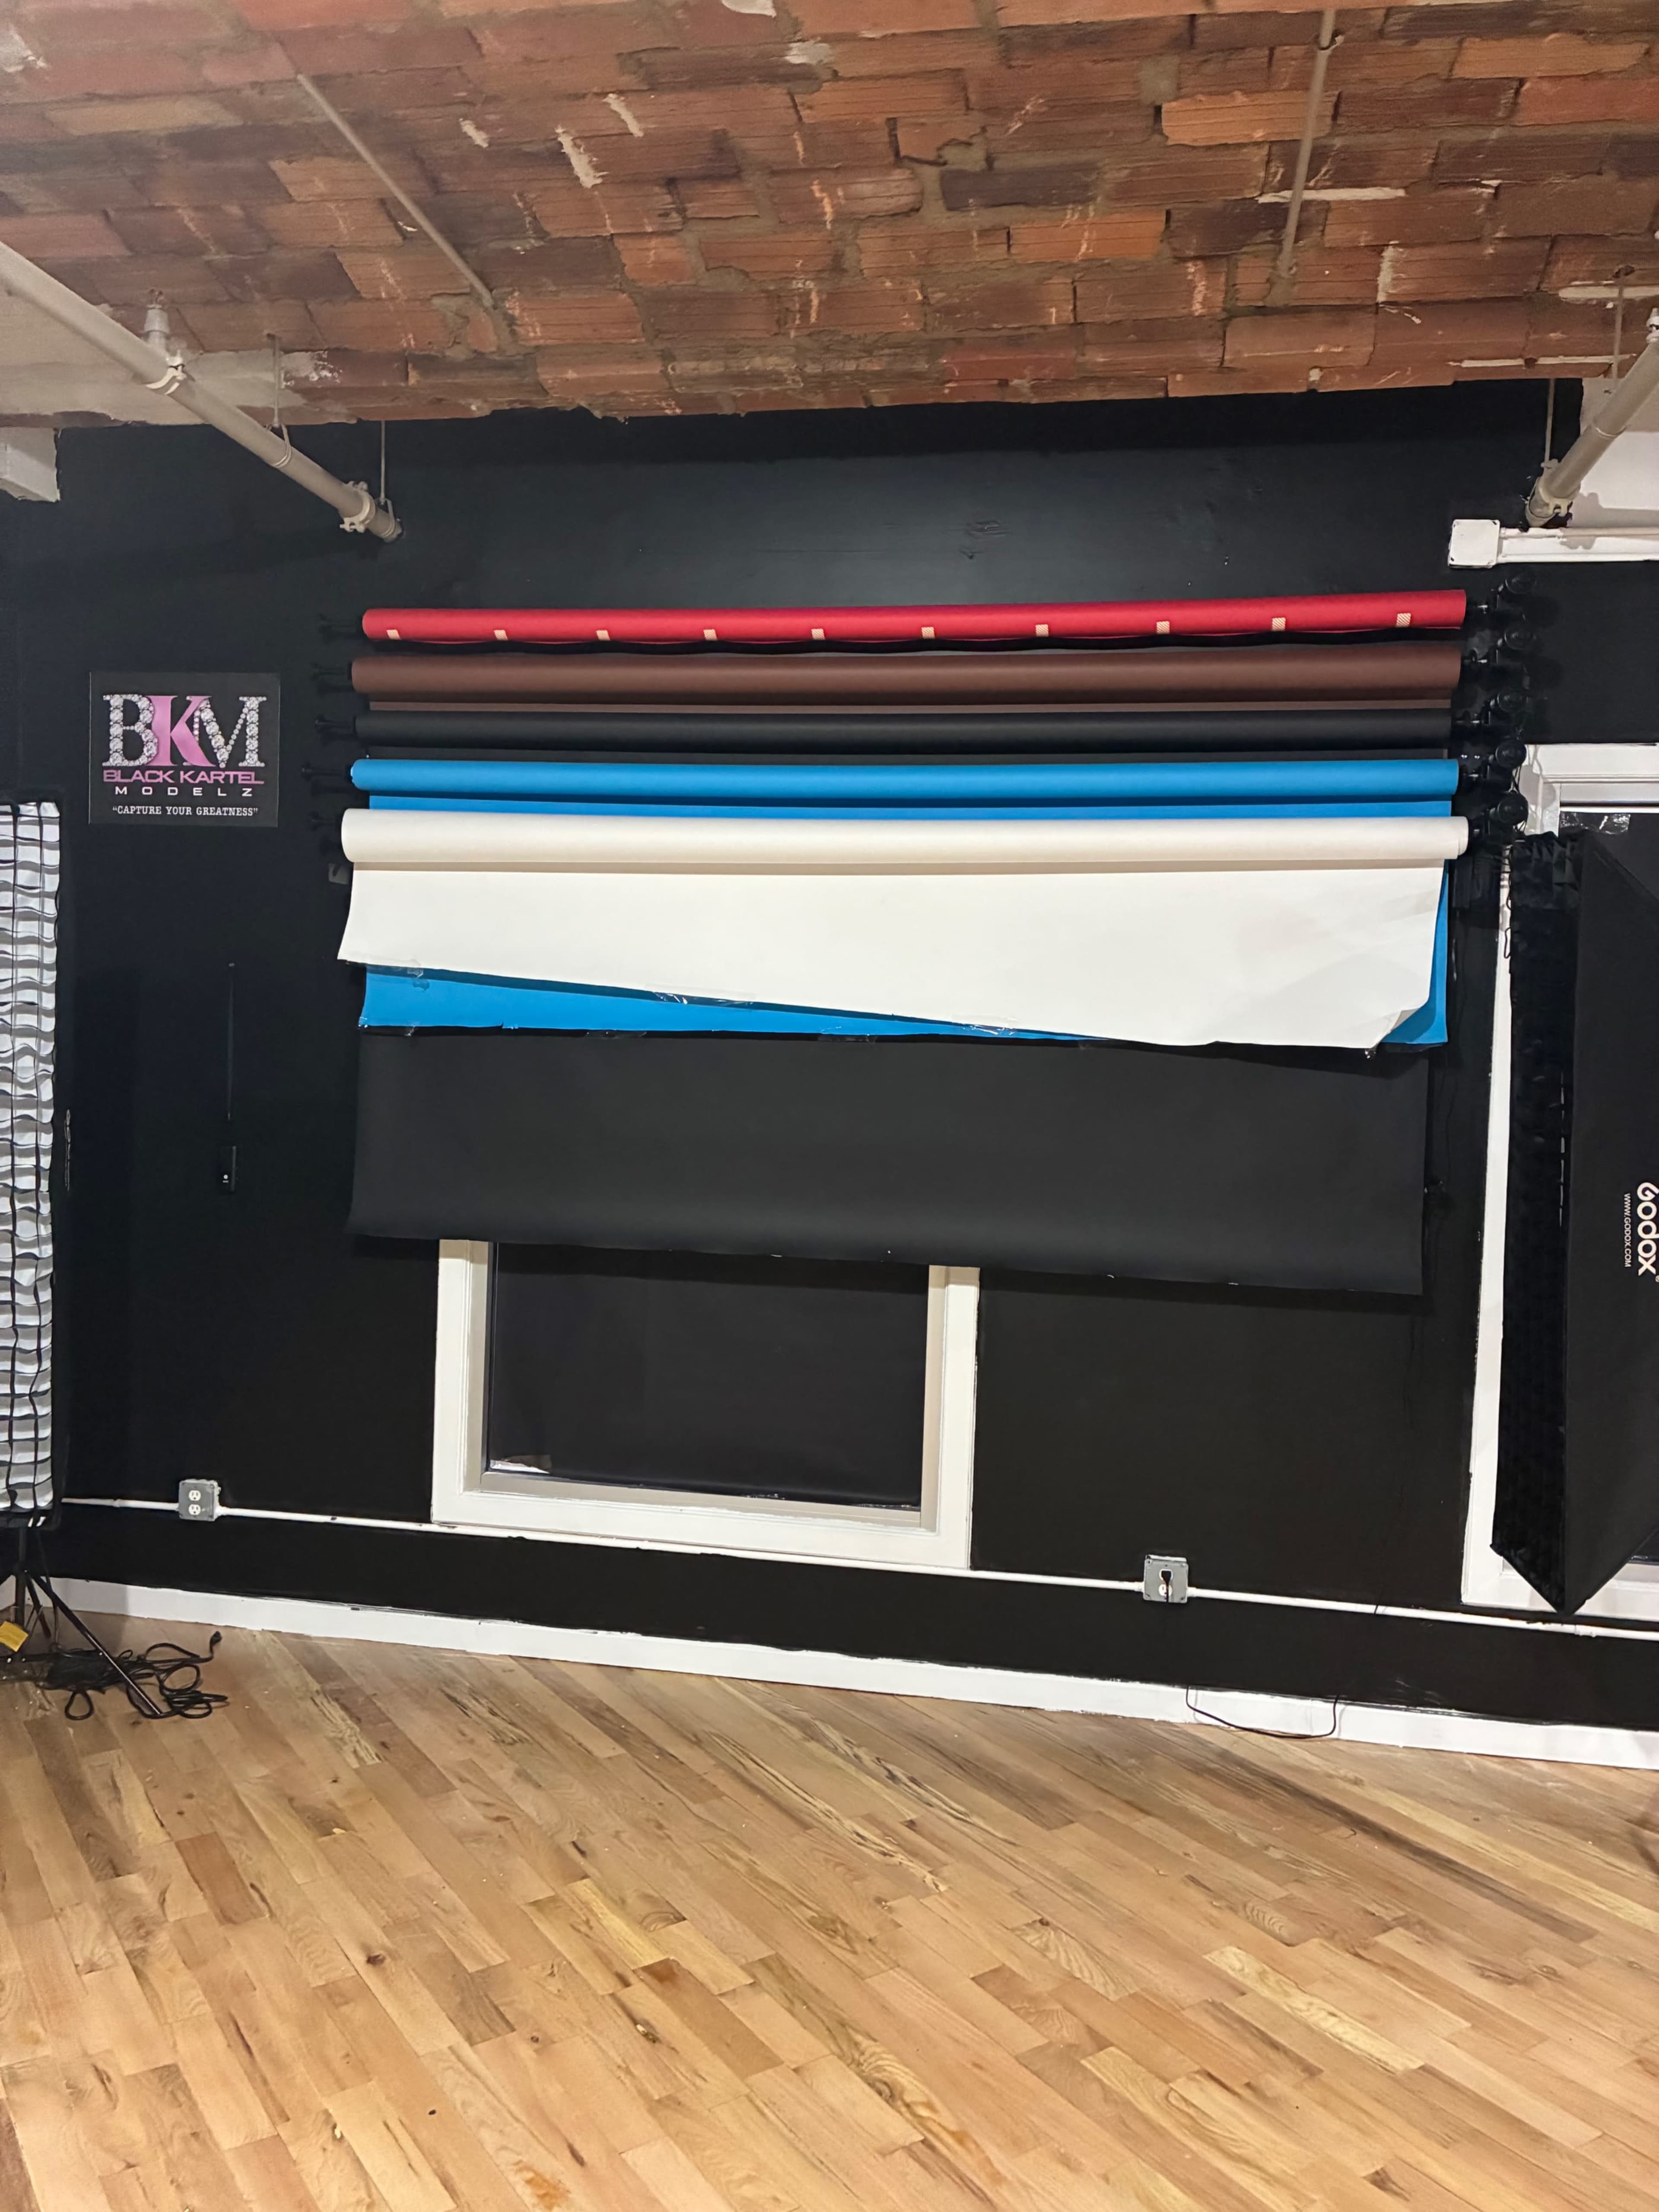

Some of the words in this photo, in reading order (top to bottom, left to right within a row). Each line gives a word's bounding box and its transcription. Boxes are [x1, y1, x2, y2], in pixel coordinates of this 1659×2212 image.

[102, 694, 267, 768] BKM
[103, 770, 175, 783] BLACK
[180, 770, 264, 784] KARTEL
[115, 786, 252, 797] MODELZ
[165, 806, 192, 815] YOUR
